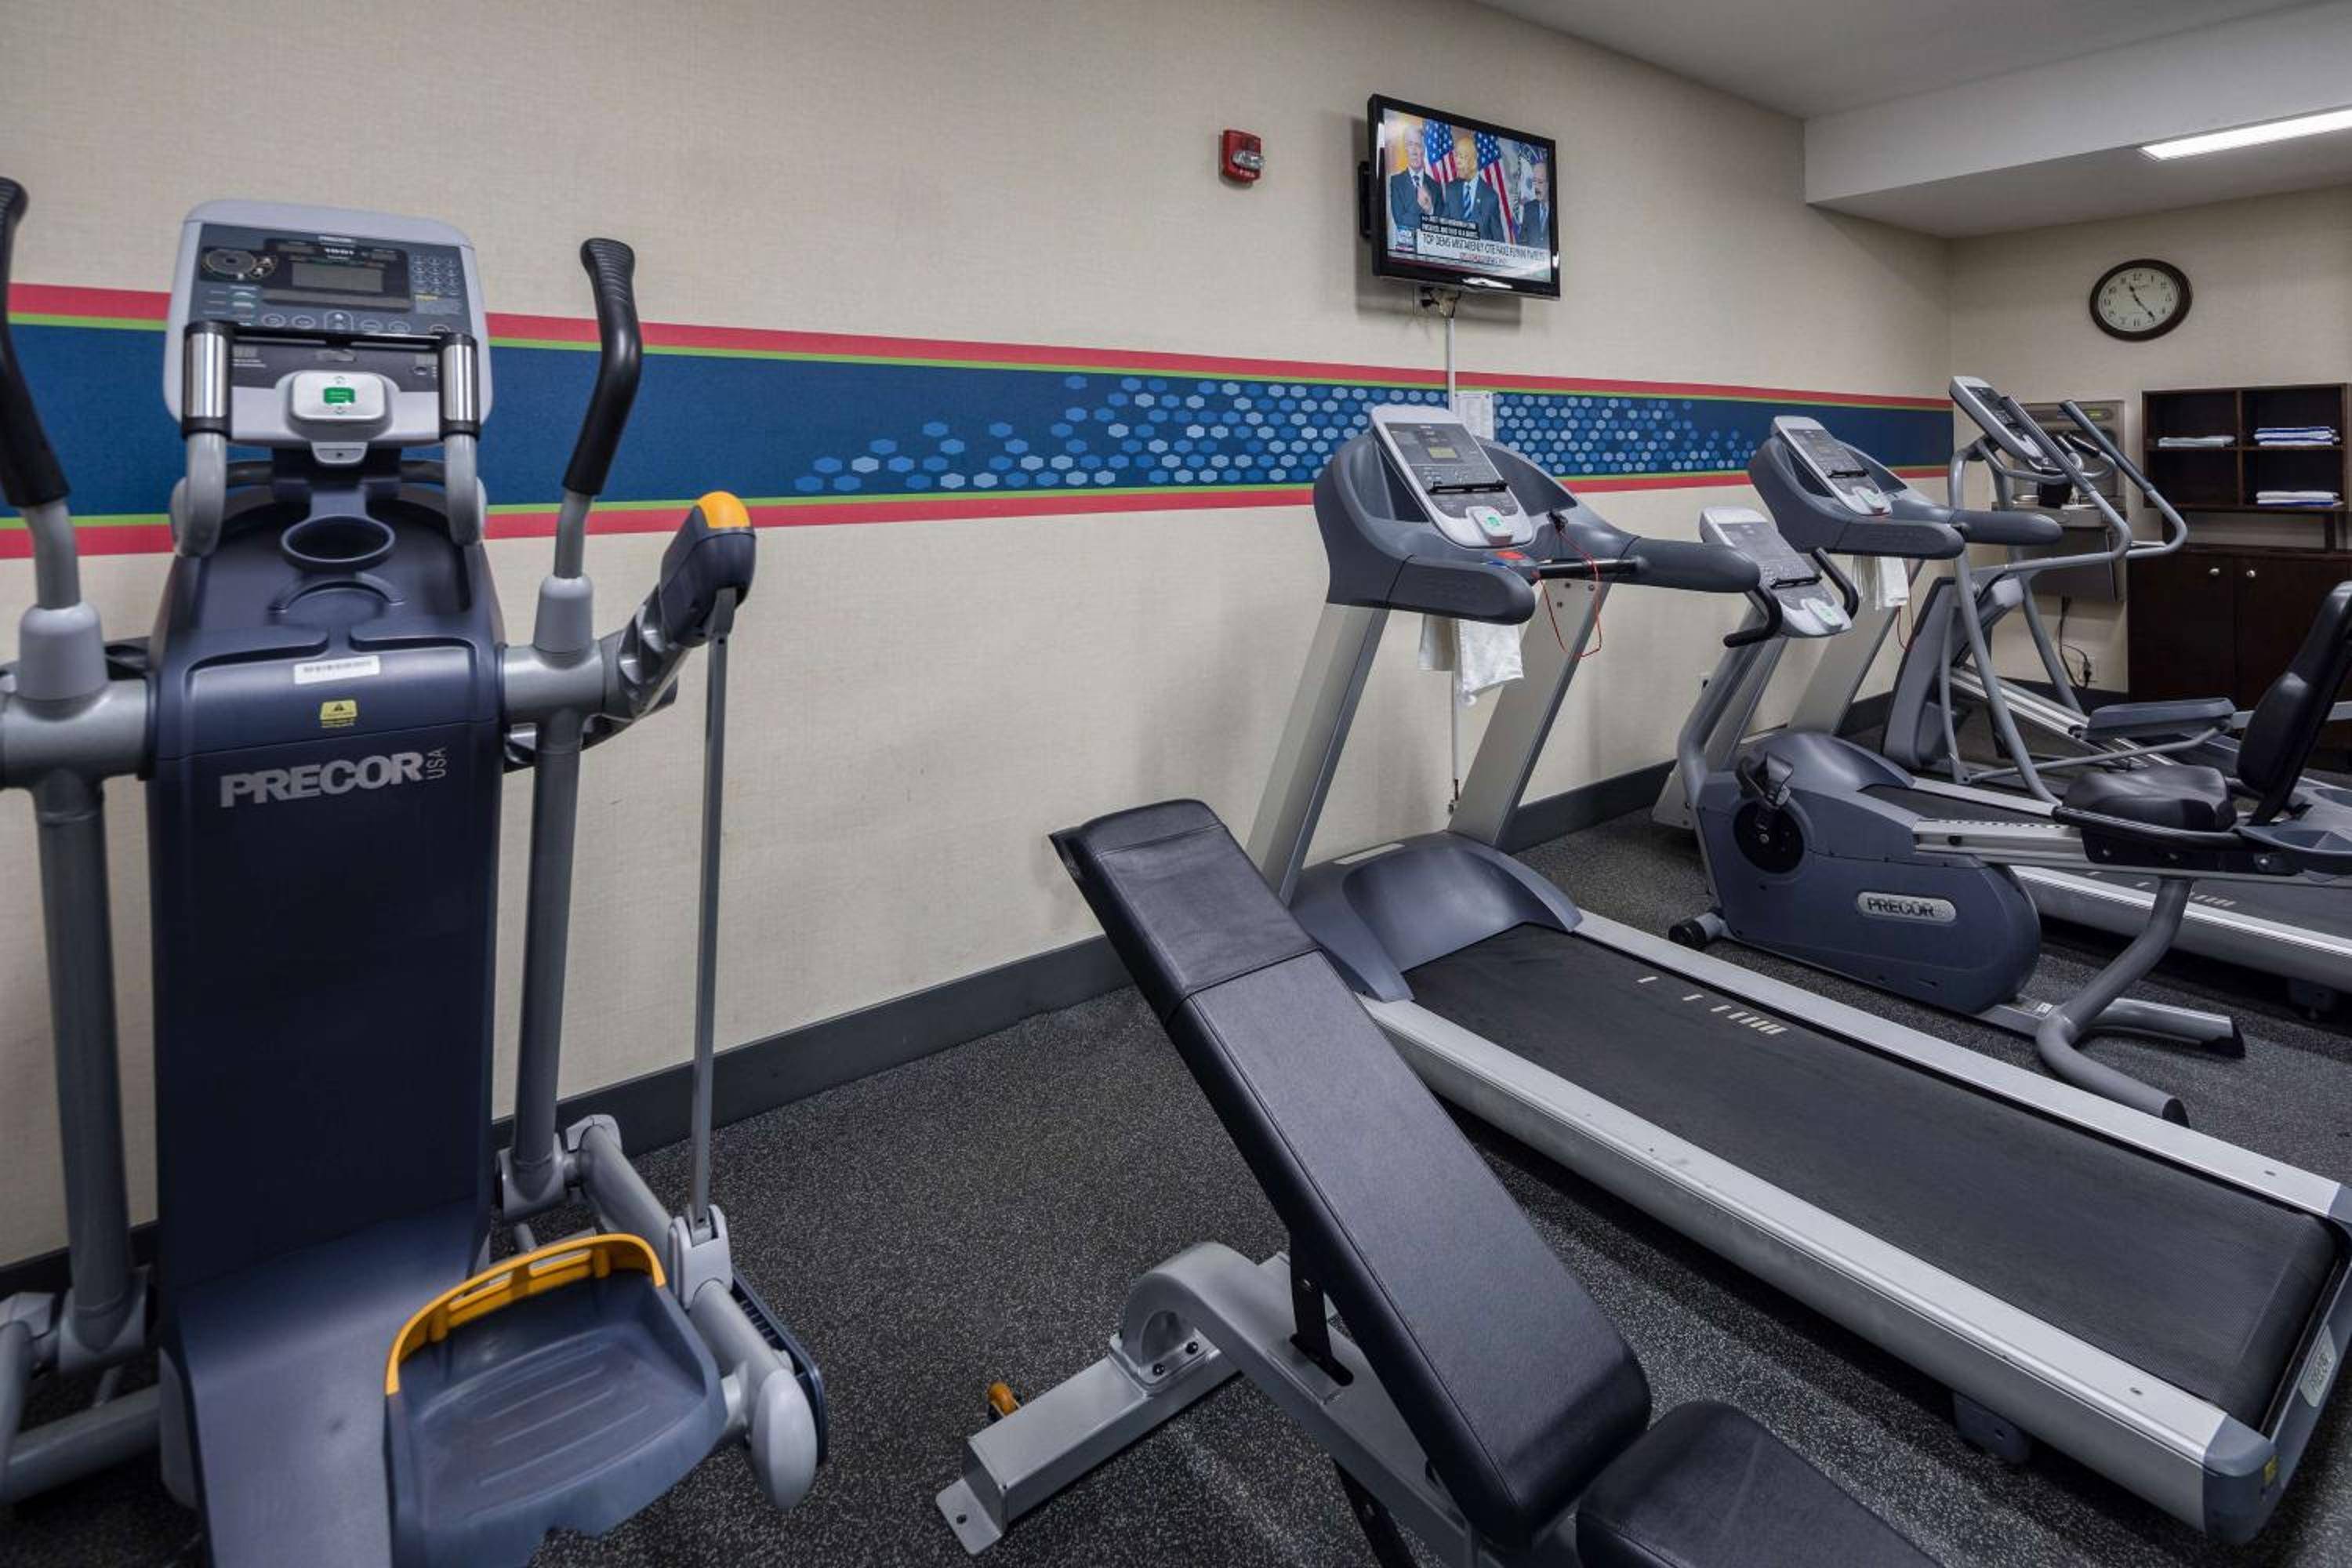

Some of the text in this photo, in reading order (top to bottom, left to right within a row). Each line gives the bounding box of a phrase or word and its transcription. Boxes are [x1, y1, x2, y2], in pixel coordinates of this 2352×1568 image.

[220, 746, 448, 808] PRECOR USA
[1866, 897, 1935, 917] PRECOR
